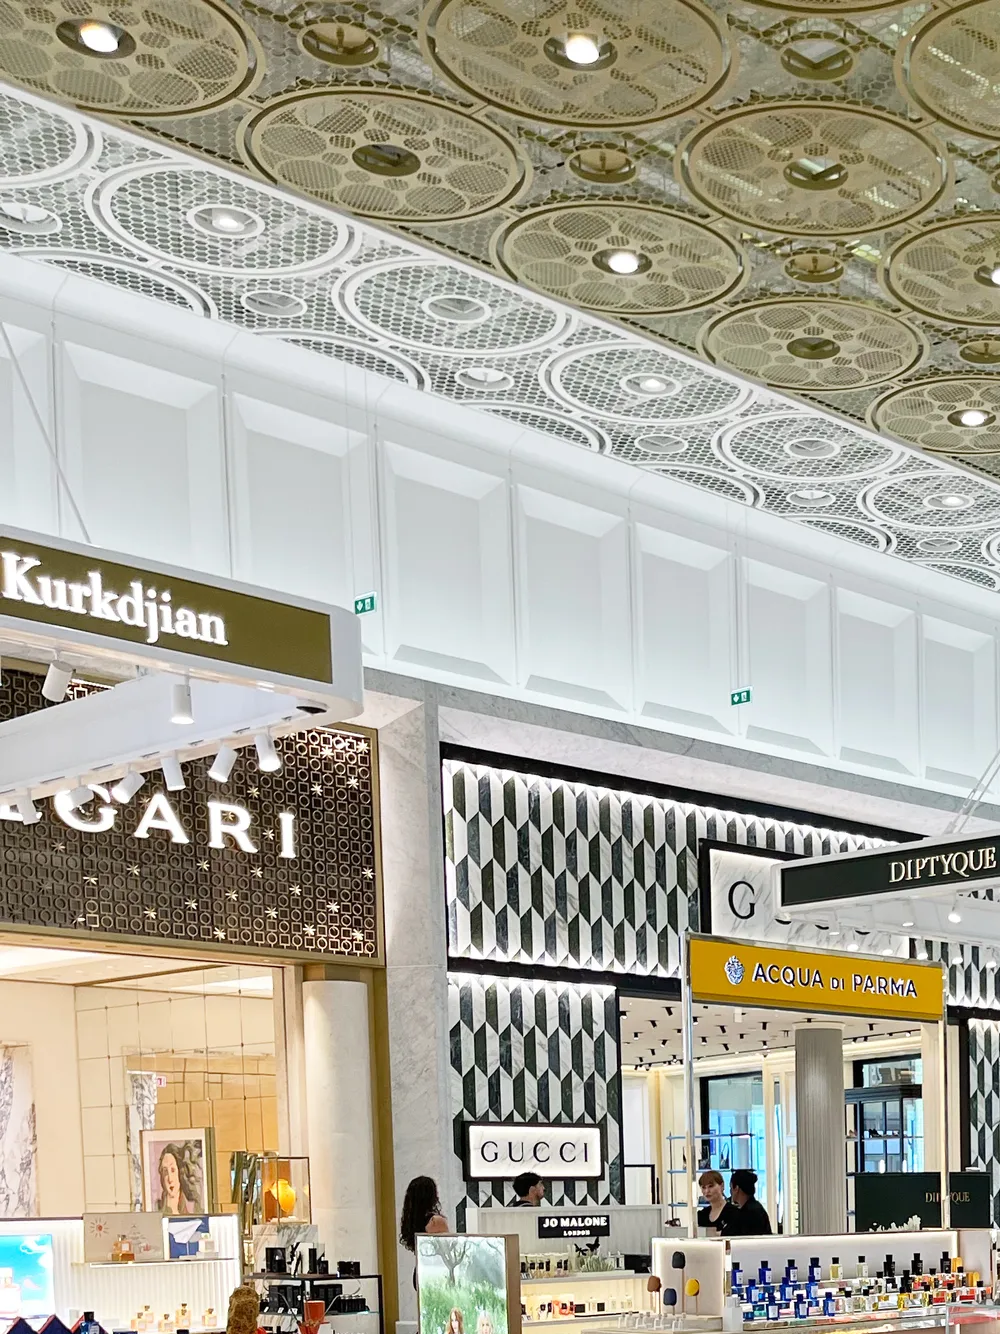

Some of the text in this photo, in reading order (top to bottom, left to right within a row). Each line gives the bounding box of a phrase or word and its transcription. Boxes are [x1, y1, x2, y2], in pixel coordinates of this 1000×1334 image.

[1, 551, 229, 645] Kurkdjian
[888, 846, 997, 883] DIPTYQUE
[752, 963, 824, 988] ACQUA
[852, 974, 918, 998] PARMA
[480, 1140, 589, 1163] GUCCI
[925, 1191, 971, 1206] DIQUE
[542, 1216, 608, 1228] JO MALONE
[563, 1229, 591, 1237] LONDON
